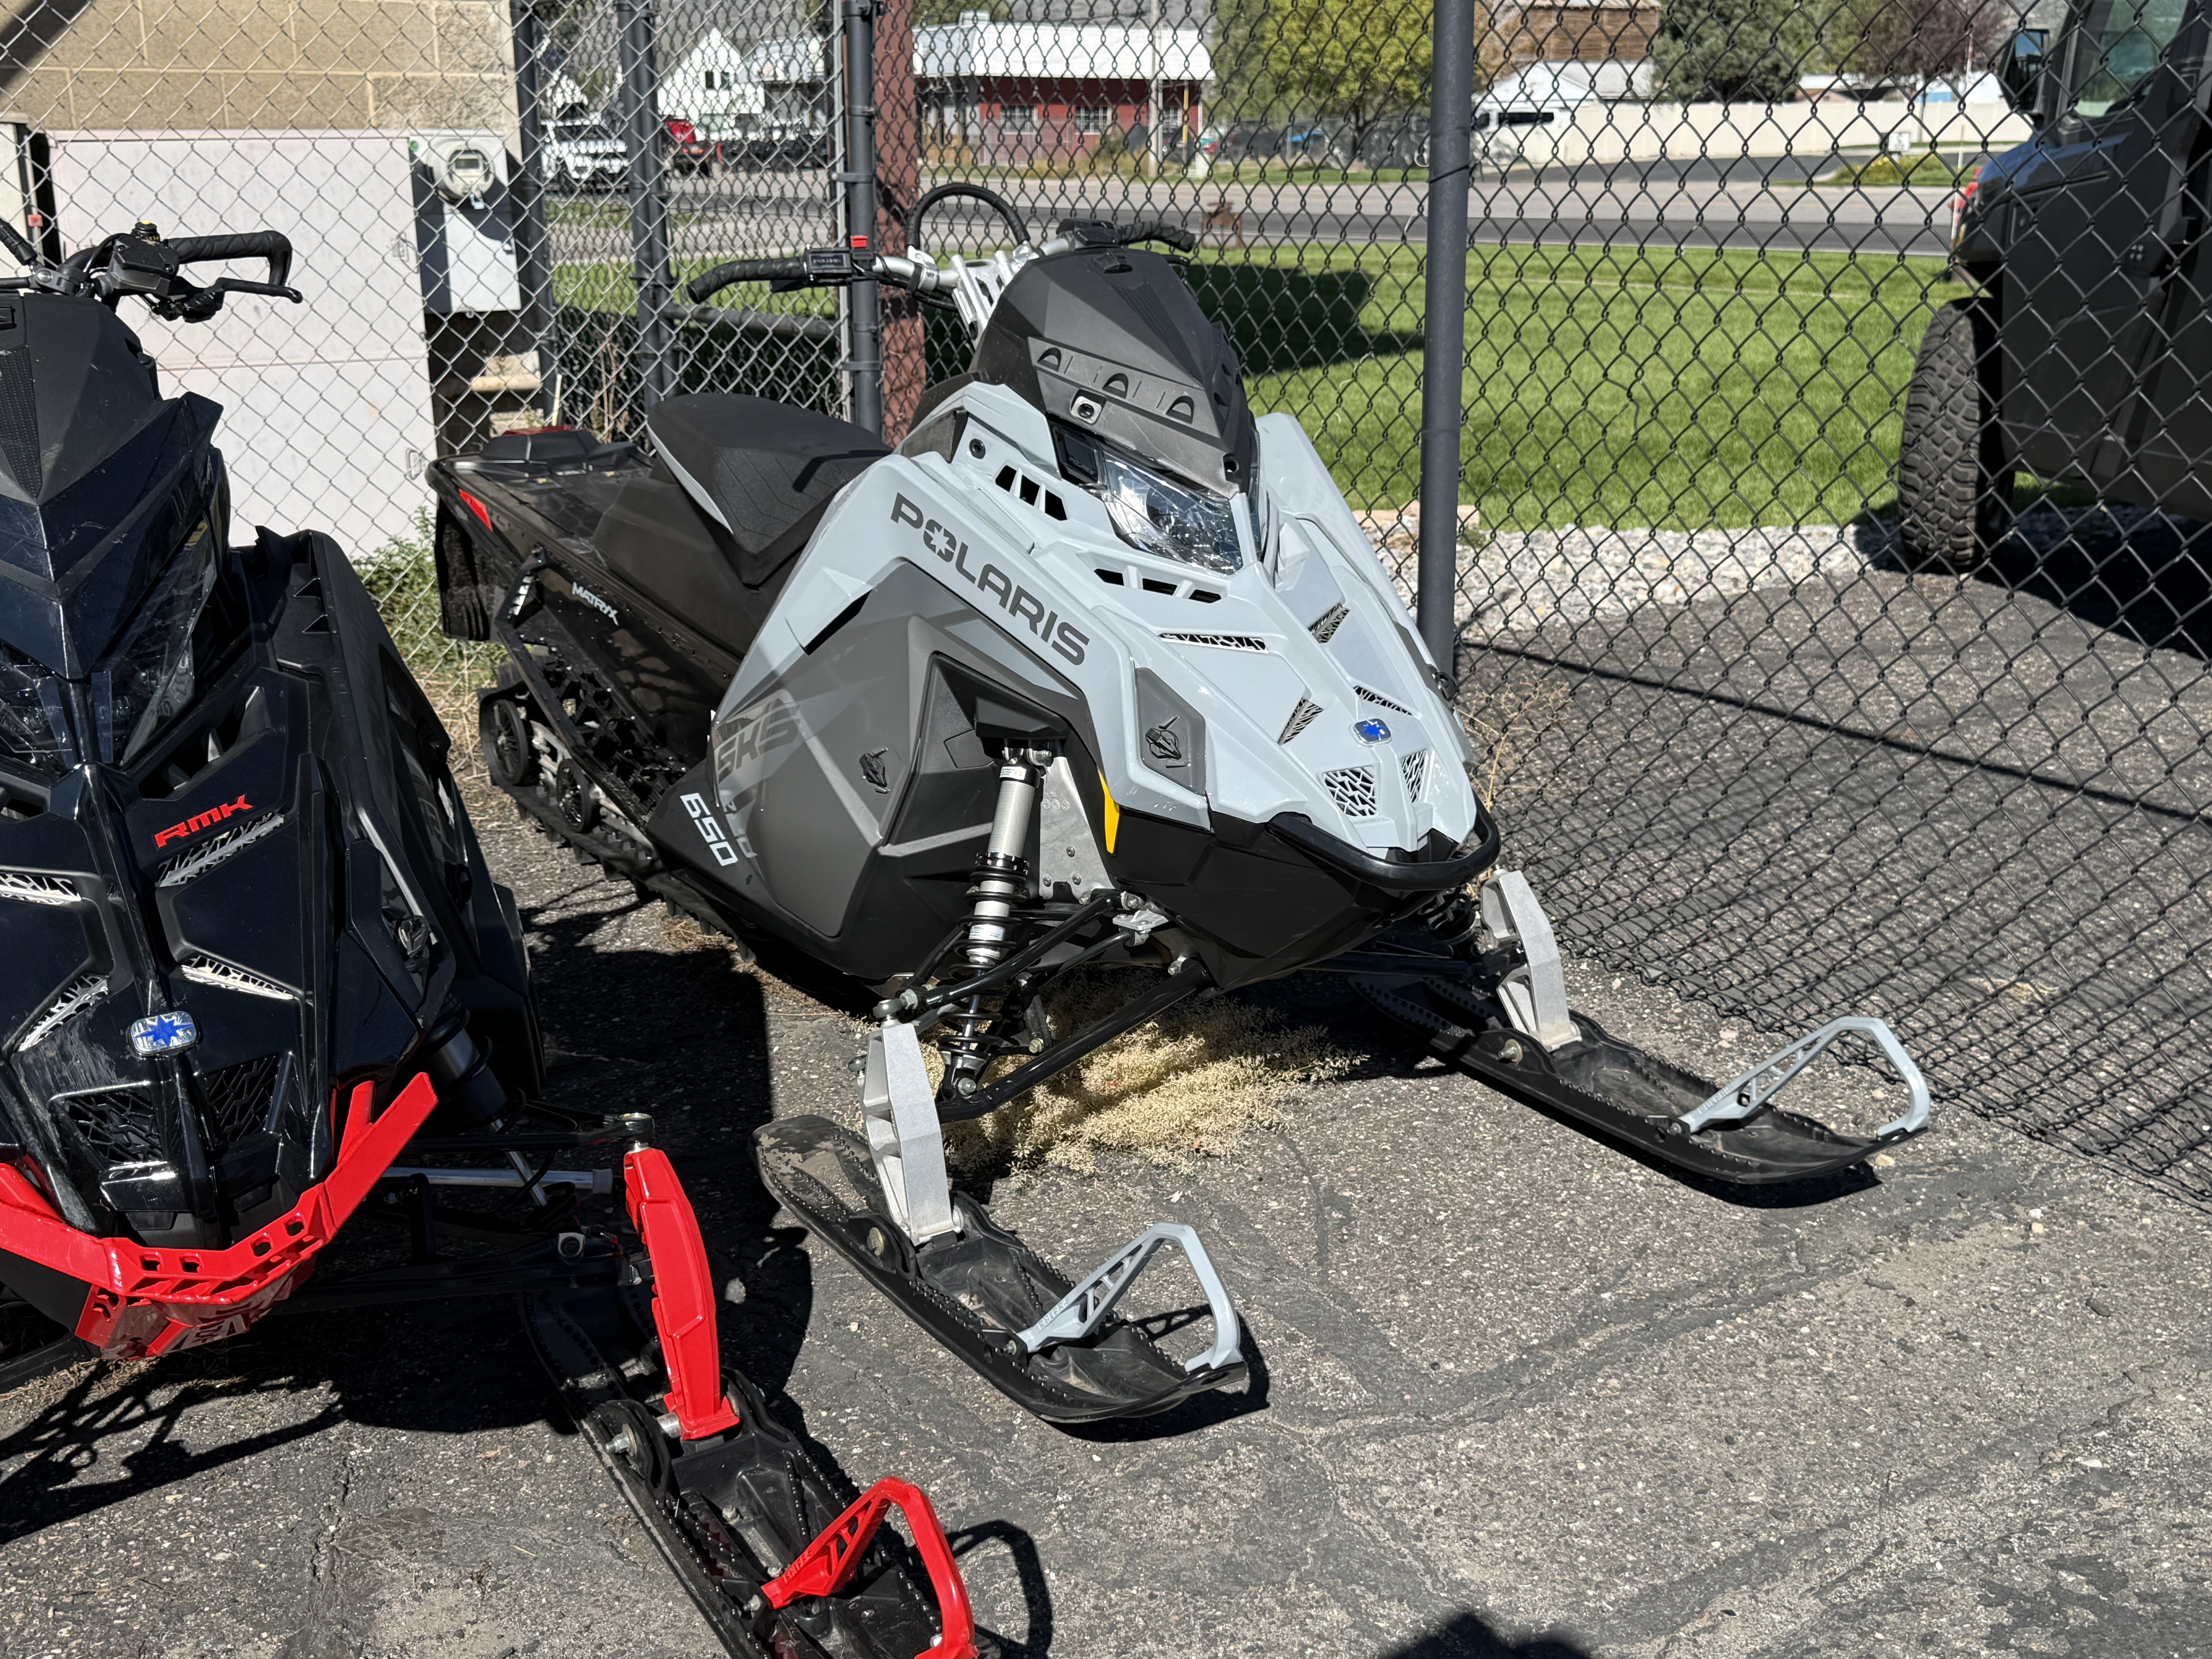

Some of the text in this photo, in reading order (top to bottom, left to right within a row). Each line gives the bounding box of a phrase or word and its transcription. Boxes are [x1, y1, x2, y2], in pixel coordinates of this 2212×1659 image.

[1069, 457, 1095, 476] POLARIS
[572, 582, 619, 626] MATRYX
[891, 492, 1090, 666] POLARIS
[718, 705, 802, 785] SKS
[155, 794, 253, 848] RMK
[680, 793, 738, 866] 650
